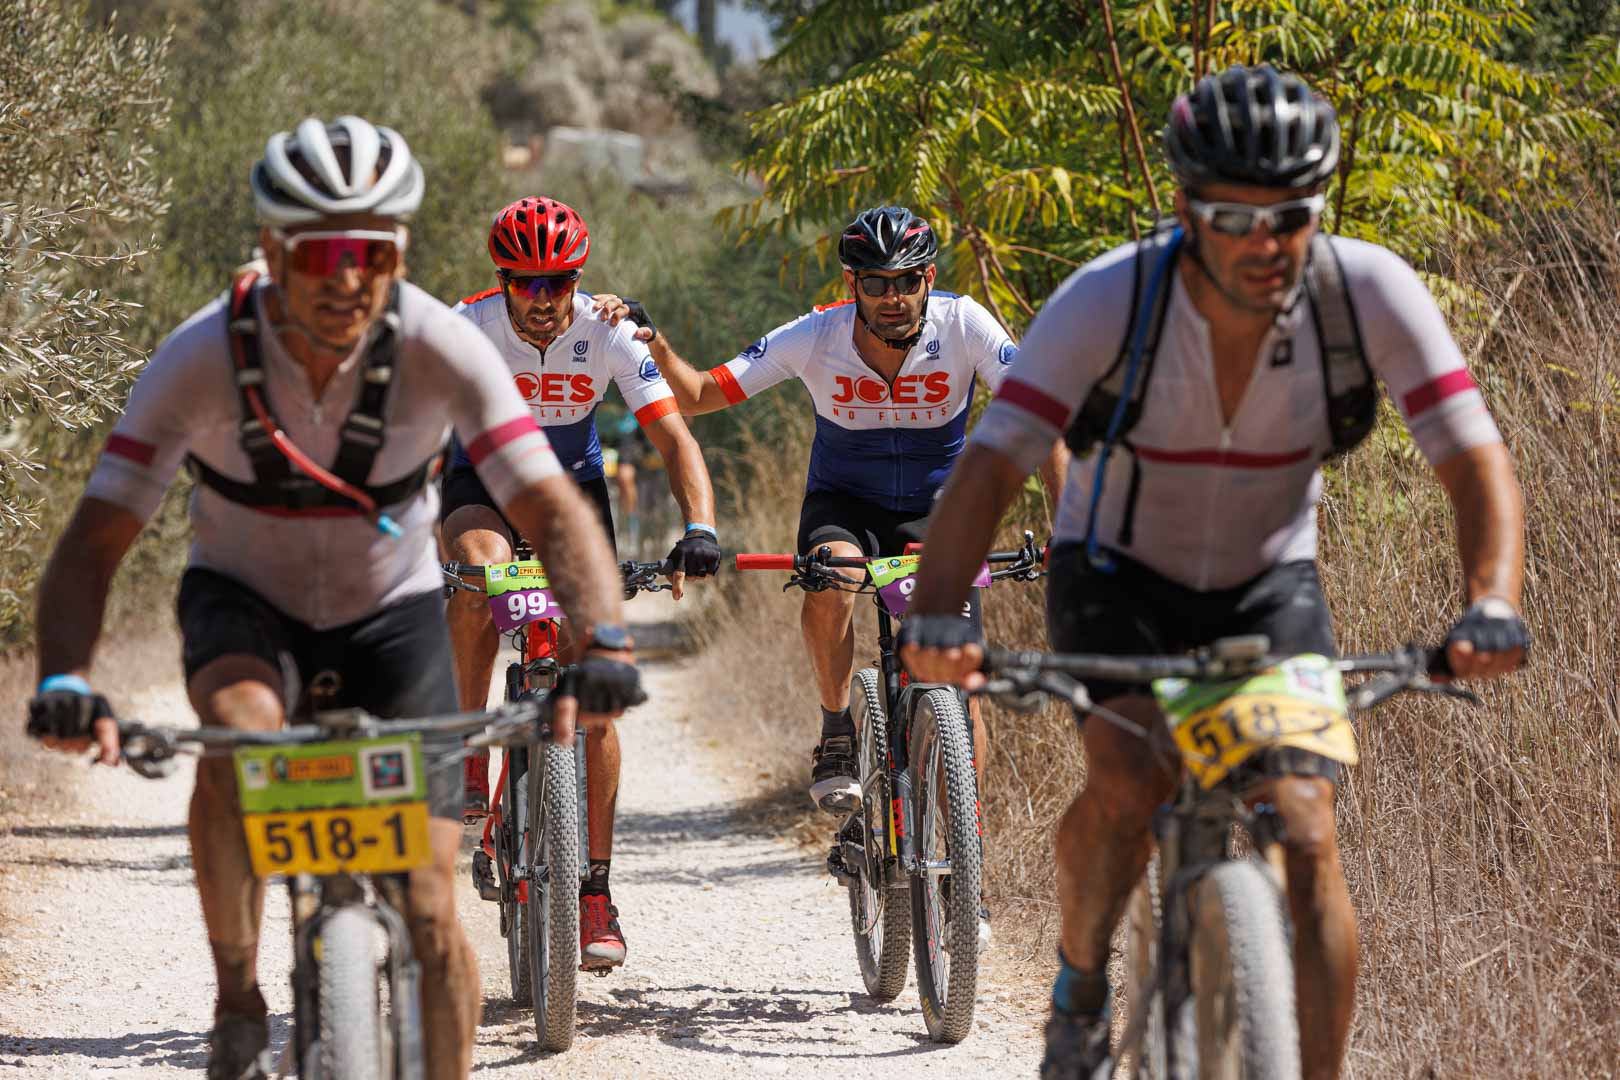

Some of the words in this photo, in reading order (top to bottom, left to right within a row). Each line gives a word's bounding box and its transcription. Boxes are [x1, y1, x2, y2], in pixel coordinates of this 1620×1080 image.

[833, 407, 855, 420] NO
[879, 406, 947, 421] FLATS
[264, 812, 406, 864] 518-1
